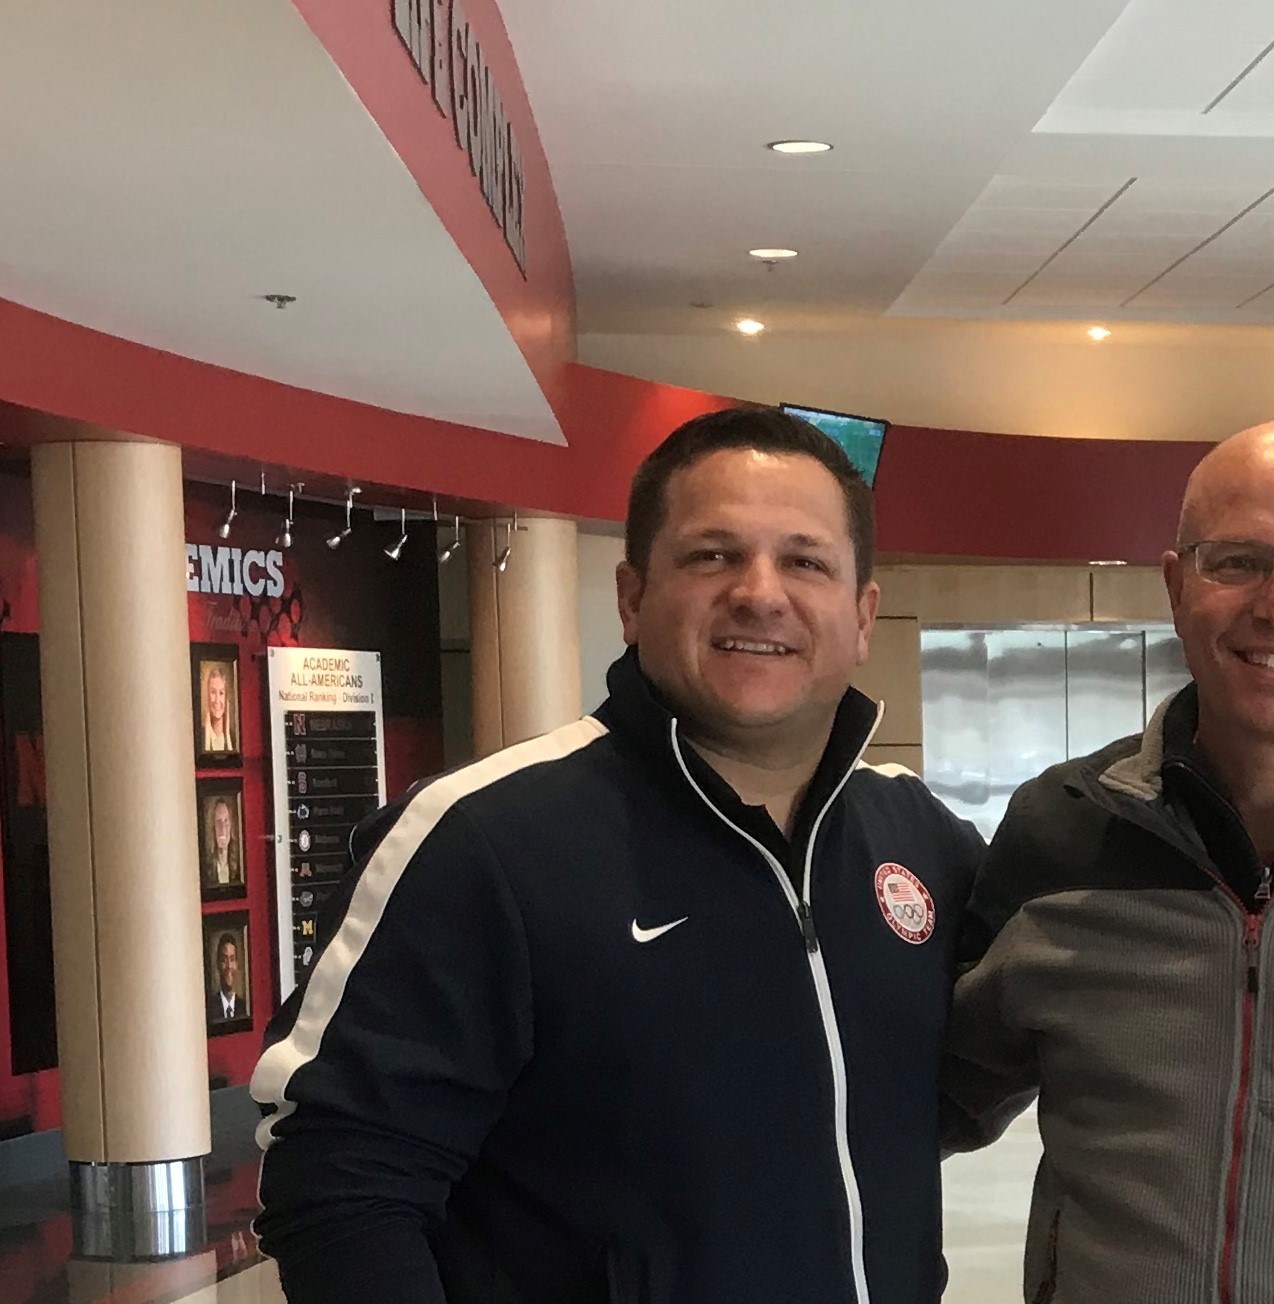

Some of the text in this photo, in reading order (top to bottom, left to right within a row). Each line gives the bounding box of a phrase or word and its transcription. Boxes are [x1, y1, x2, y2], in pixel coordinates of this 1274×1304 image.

[303, 657, 350, 672] ACADEMIC
[290, 673, 363, 689] ALL-AMERICANS
[279, 690, 307, 702] National
[309, 691, 336, 704] Ranking
[343, 692, 369, 704] Division
